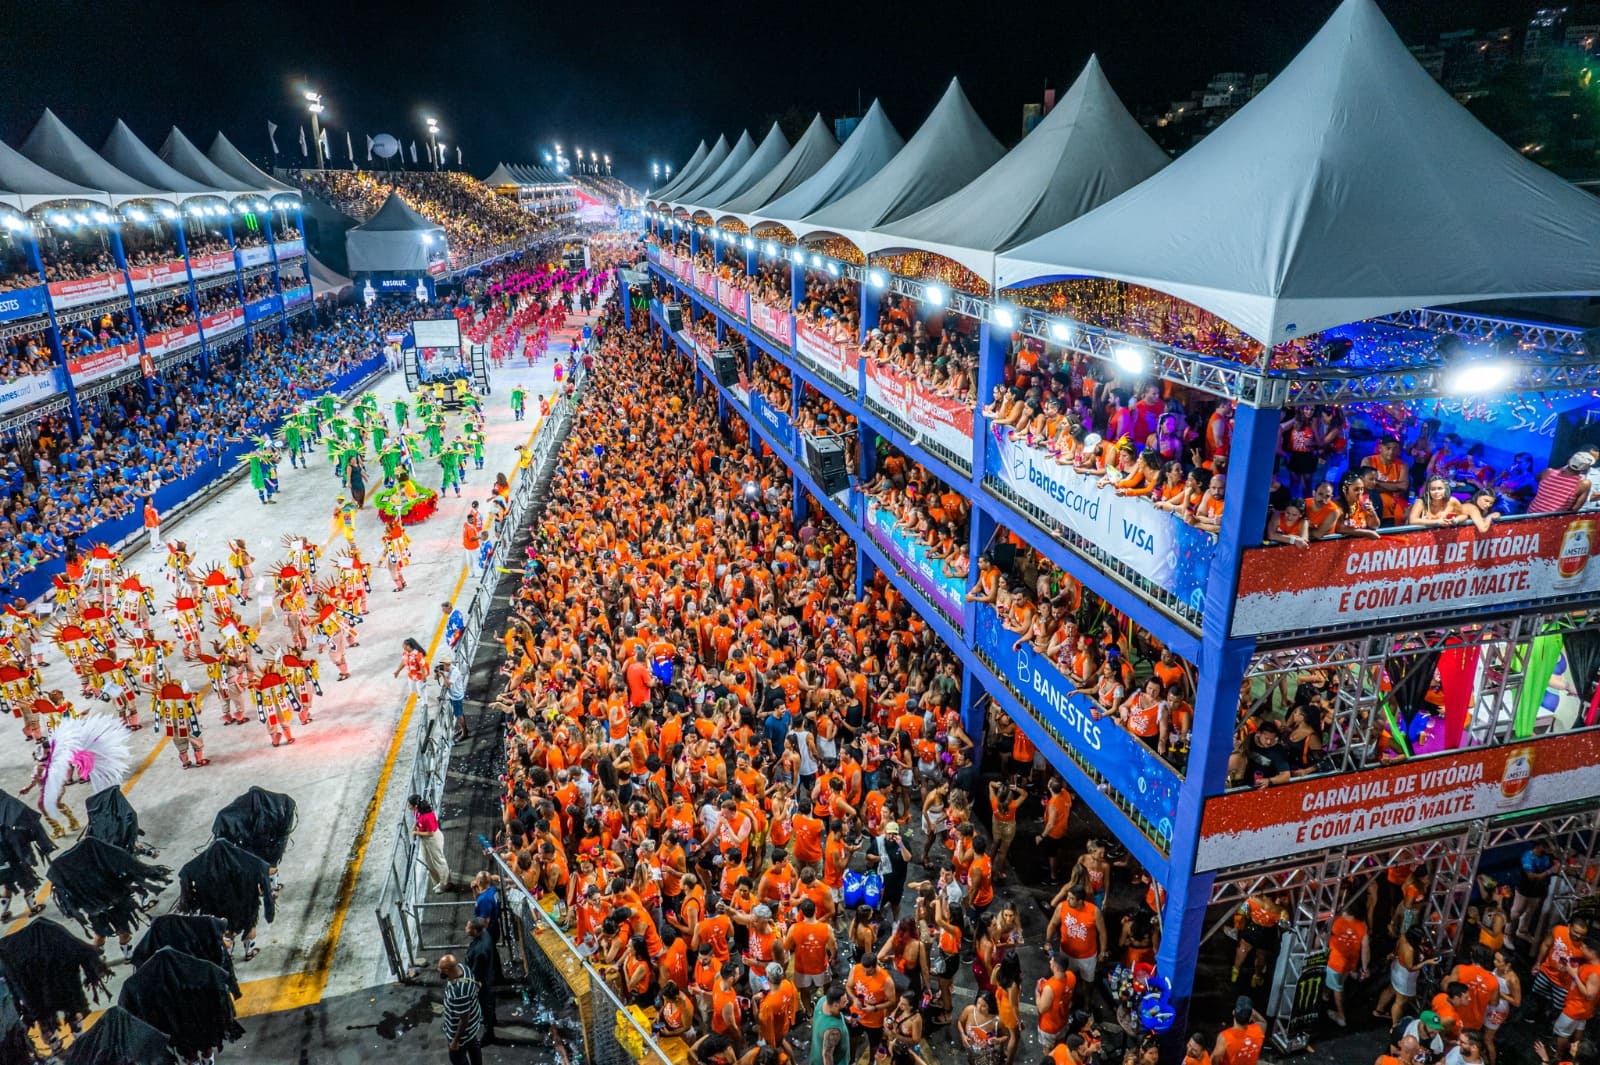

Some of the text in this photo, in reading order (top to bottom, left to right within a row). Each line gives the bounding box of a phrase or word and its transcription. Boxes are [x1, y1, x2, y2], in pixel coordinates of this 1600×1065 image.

[1028, 458, 1155, 556] banescard VISA
[1345, 529, 1540, 575] CARNAVAL DE VITÓRIA
[1353, 586, 1399, 611] COM
[1399, 584, 1413, 606] A
[1416, 578, 1467, 603] PURO
[1469, 570, 1531, 597] MALTE.
[1033, 669, 1102, 751] BANESTES
[1301, 761, 1484, 812] CARNAVAL DE VITÓRIA
[1310, 817, 1352, 840] COM
[1353, 814, 1365, 833] A
[1369, 805, 1416, 830] PURO
[1418, 794, 1476, 821] MALTE.
